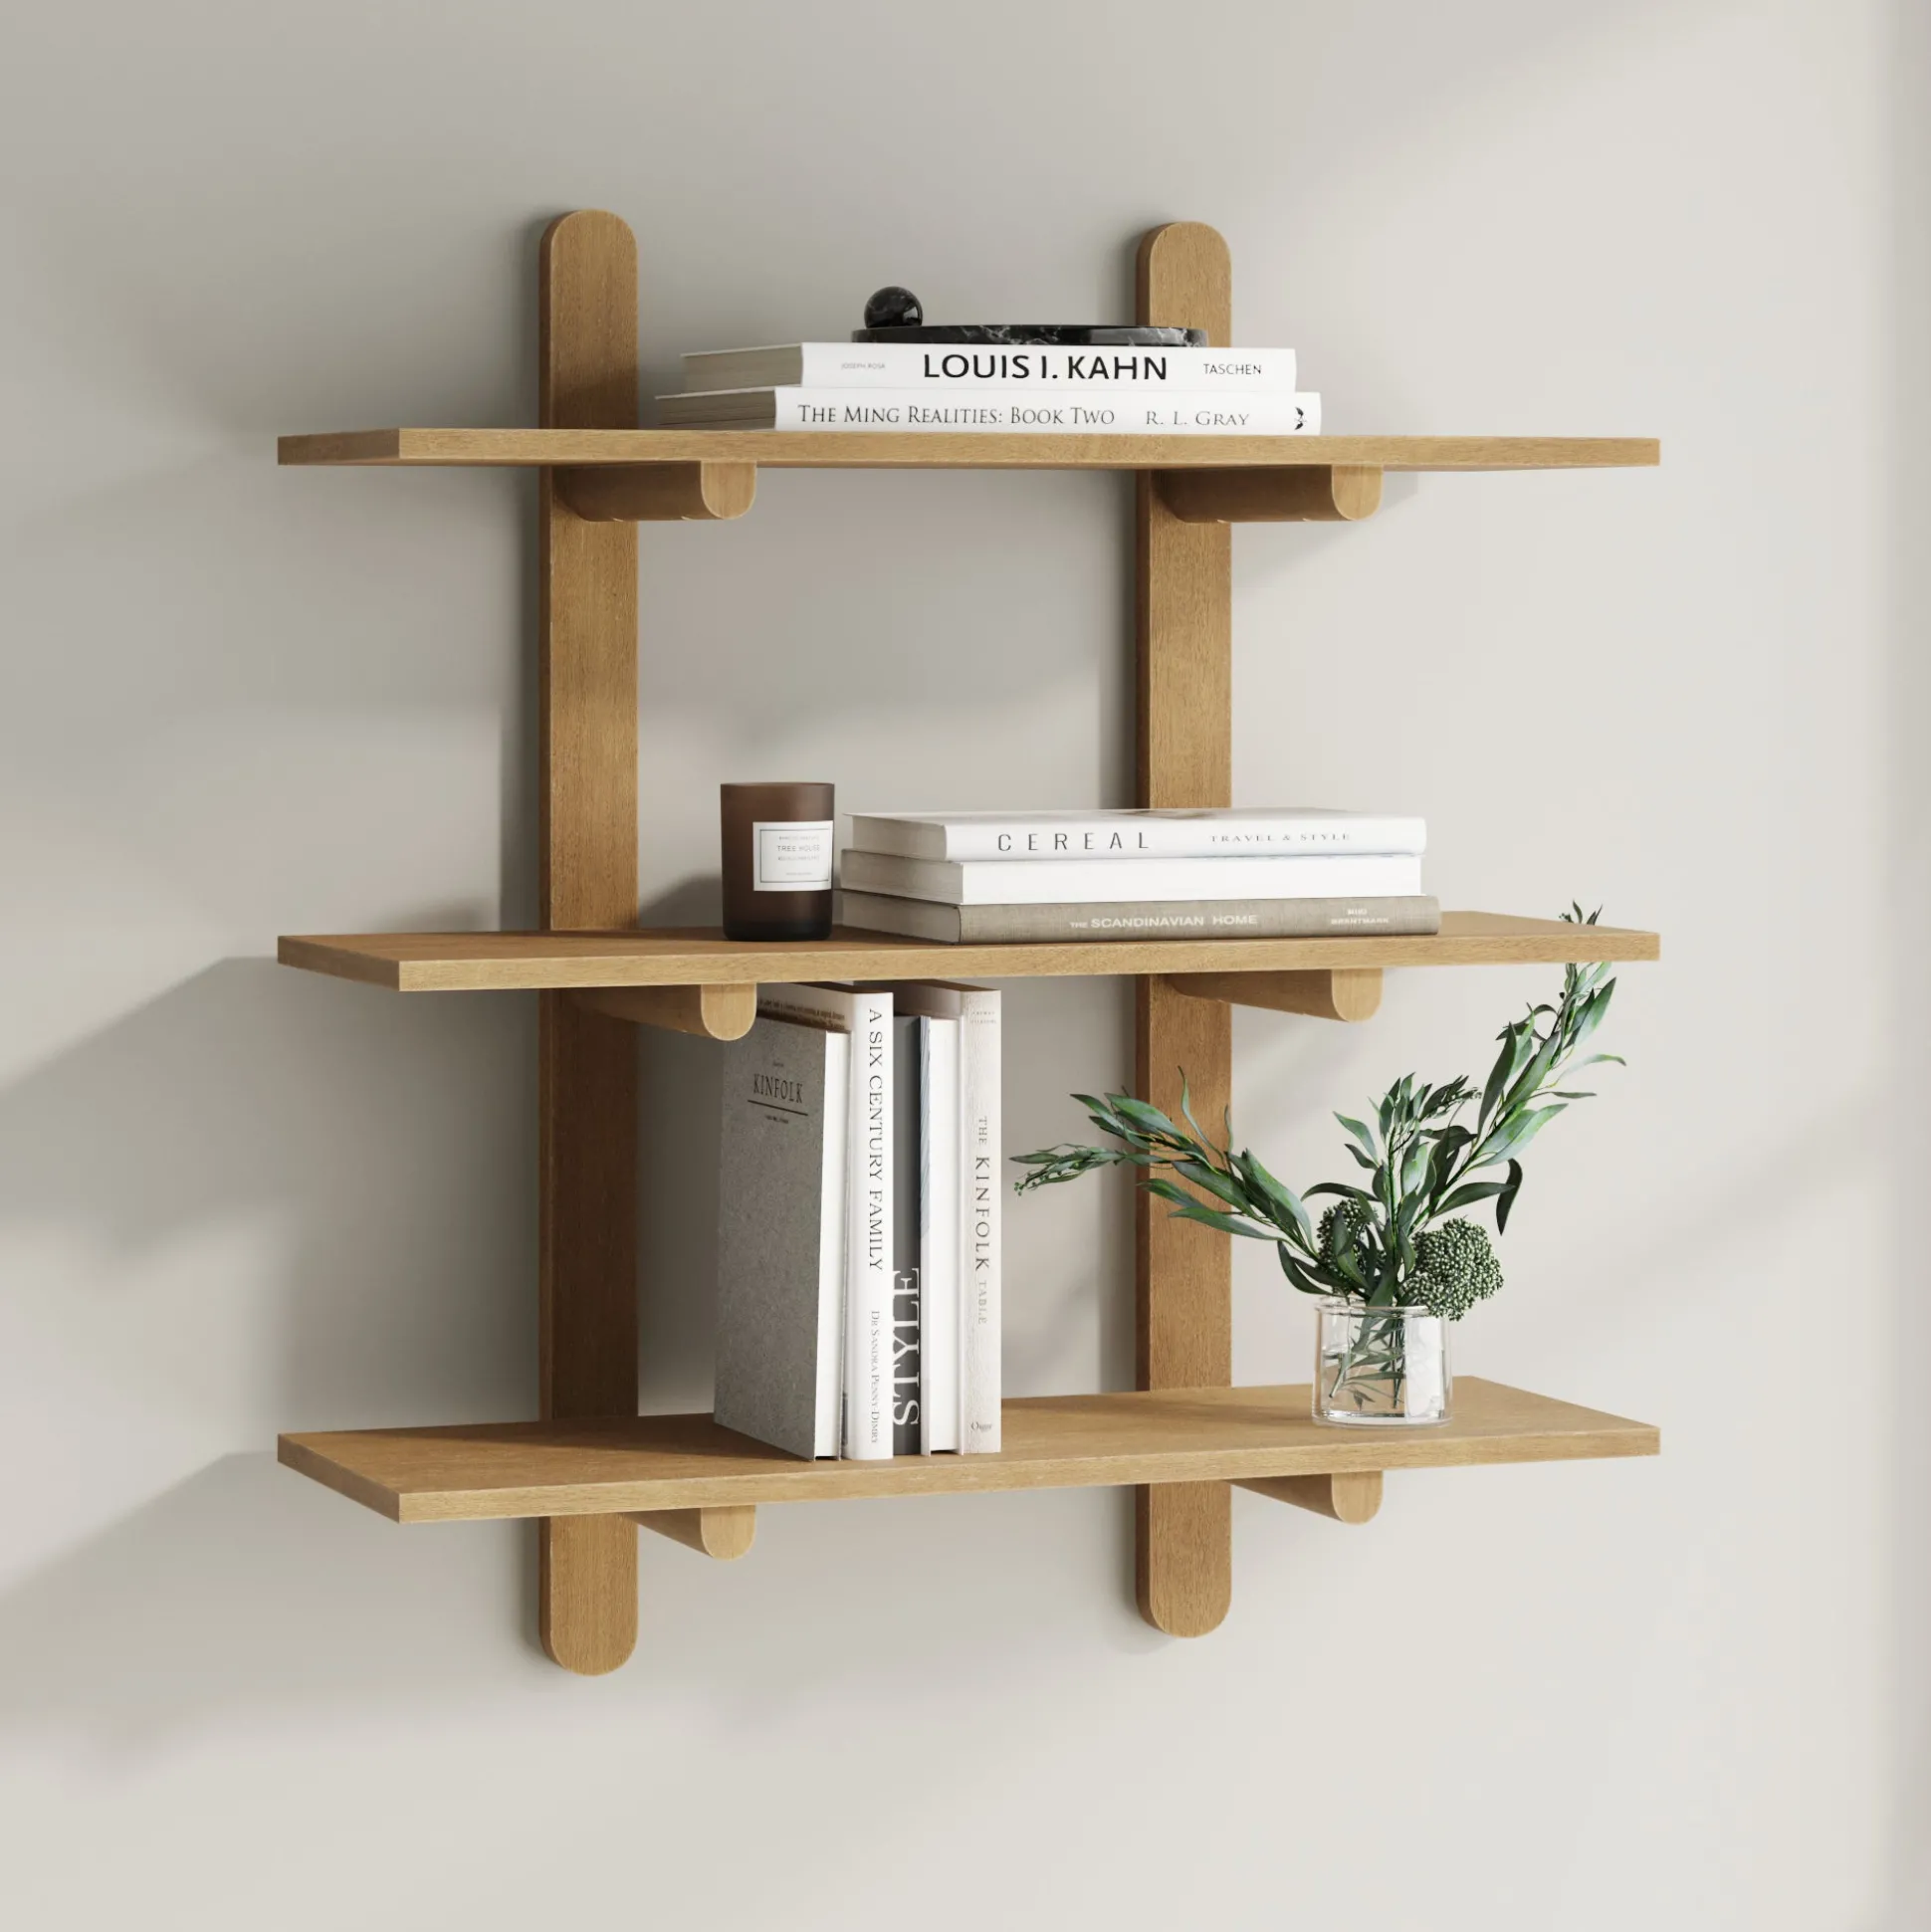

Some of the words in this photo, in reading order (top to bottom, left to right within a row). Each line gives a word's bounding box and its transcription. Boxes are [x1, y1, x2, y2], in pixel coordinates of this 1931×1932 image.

[924, 353, 1030, 379] LOUIS
[1040, 354, 1058, 380] I.
[1067, 355, 1168, 380] KAHN
[1202, 363, 1262, 375] TASCHEN
[797, 404, 836, 423] THE
[844, 405, 900, 423] MING
[907, 405, 1003, 424] REALITIES:
[1010, 406, 1064, 425] BOOK
[1070, 406, 1115, 425] TWO
[1146, 410, 1165, 426] R.
[1173, 410, 1188, 426] L.
[1194, 410, 1250, 426] GRAY
[997, 831, 1150, 852] CEREAL
[1210, 834, 1275, 843] TRAVEL
[1300, 833, 1351, 842] STYLE
[1090, 916, 1204, 929] SCANDINAVIAN
[1212, 914, 1258, 926] HOME
[869, 1008, 883, 1023] A
[869, 1031, 883, 1067] SIX
[753, 1073, 803, 1104] KINFOLK
[869, 1075, 883, 1181] CENTURY
[977, 1116, 988, 1146] THE
[975, 1156, 990, 1272] KINFOLK
[869, 1189, 883, 1272] FAMILY
[977, 1280, 988, 1325] TABLE
[893, 1267, 921, 1426] STYLE
